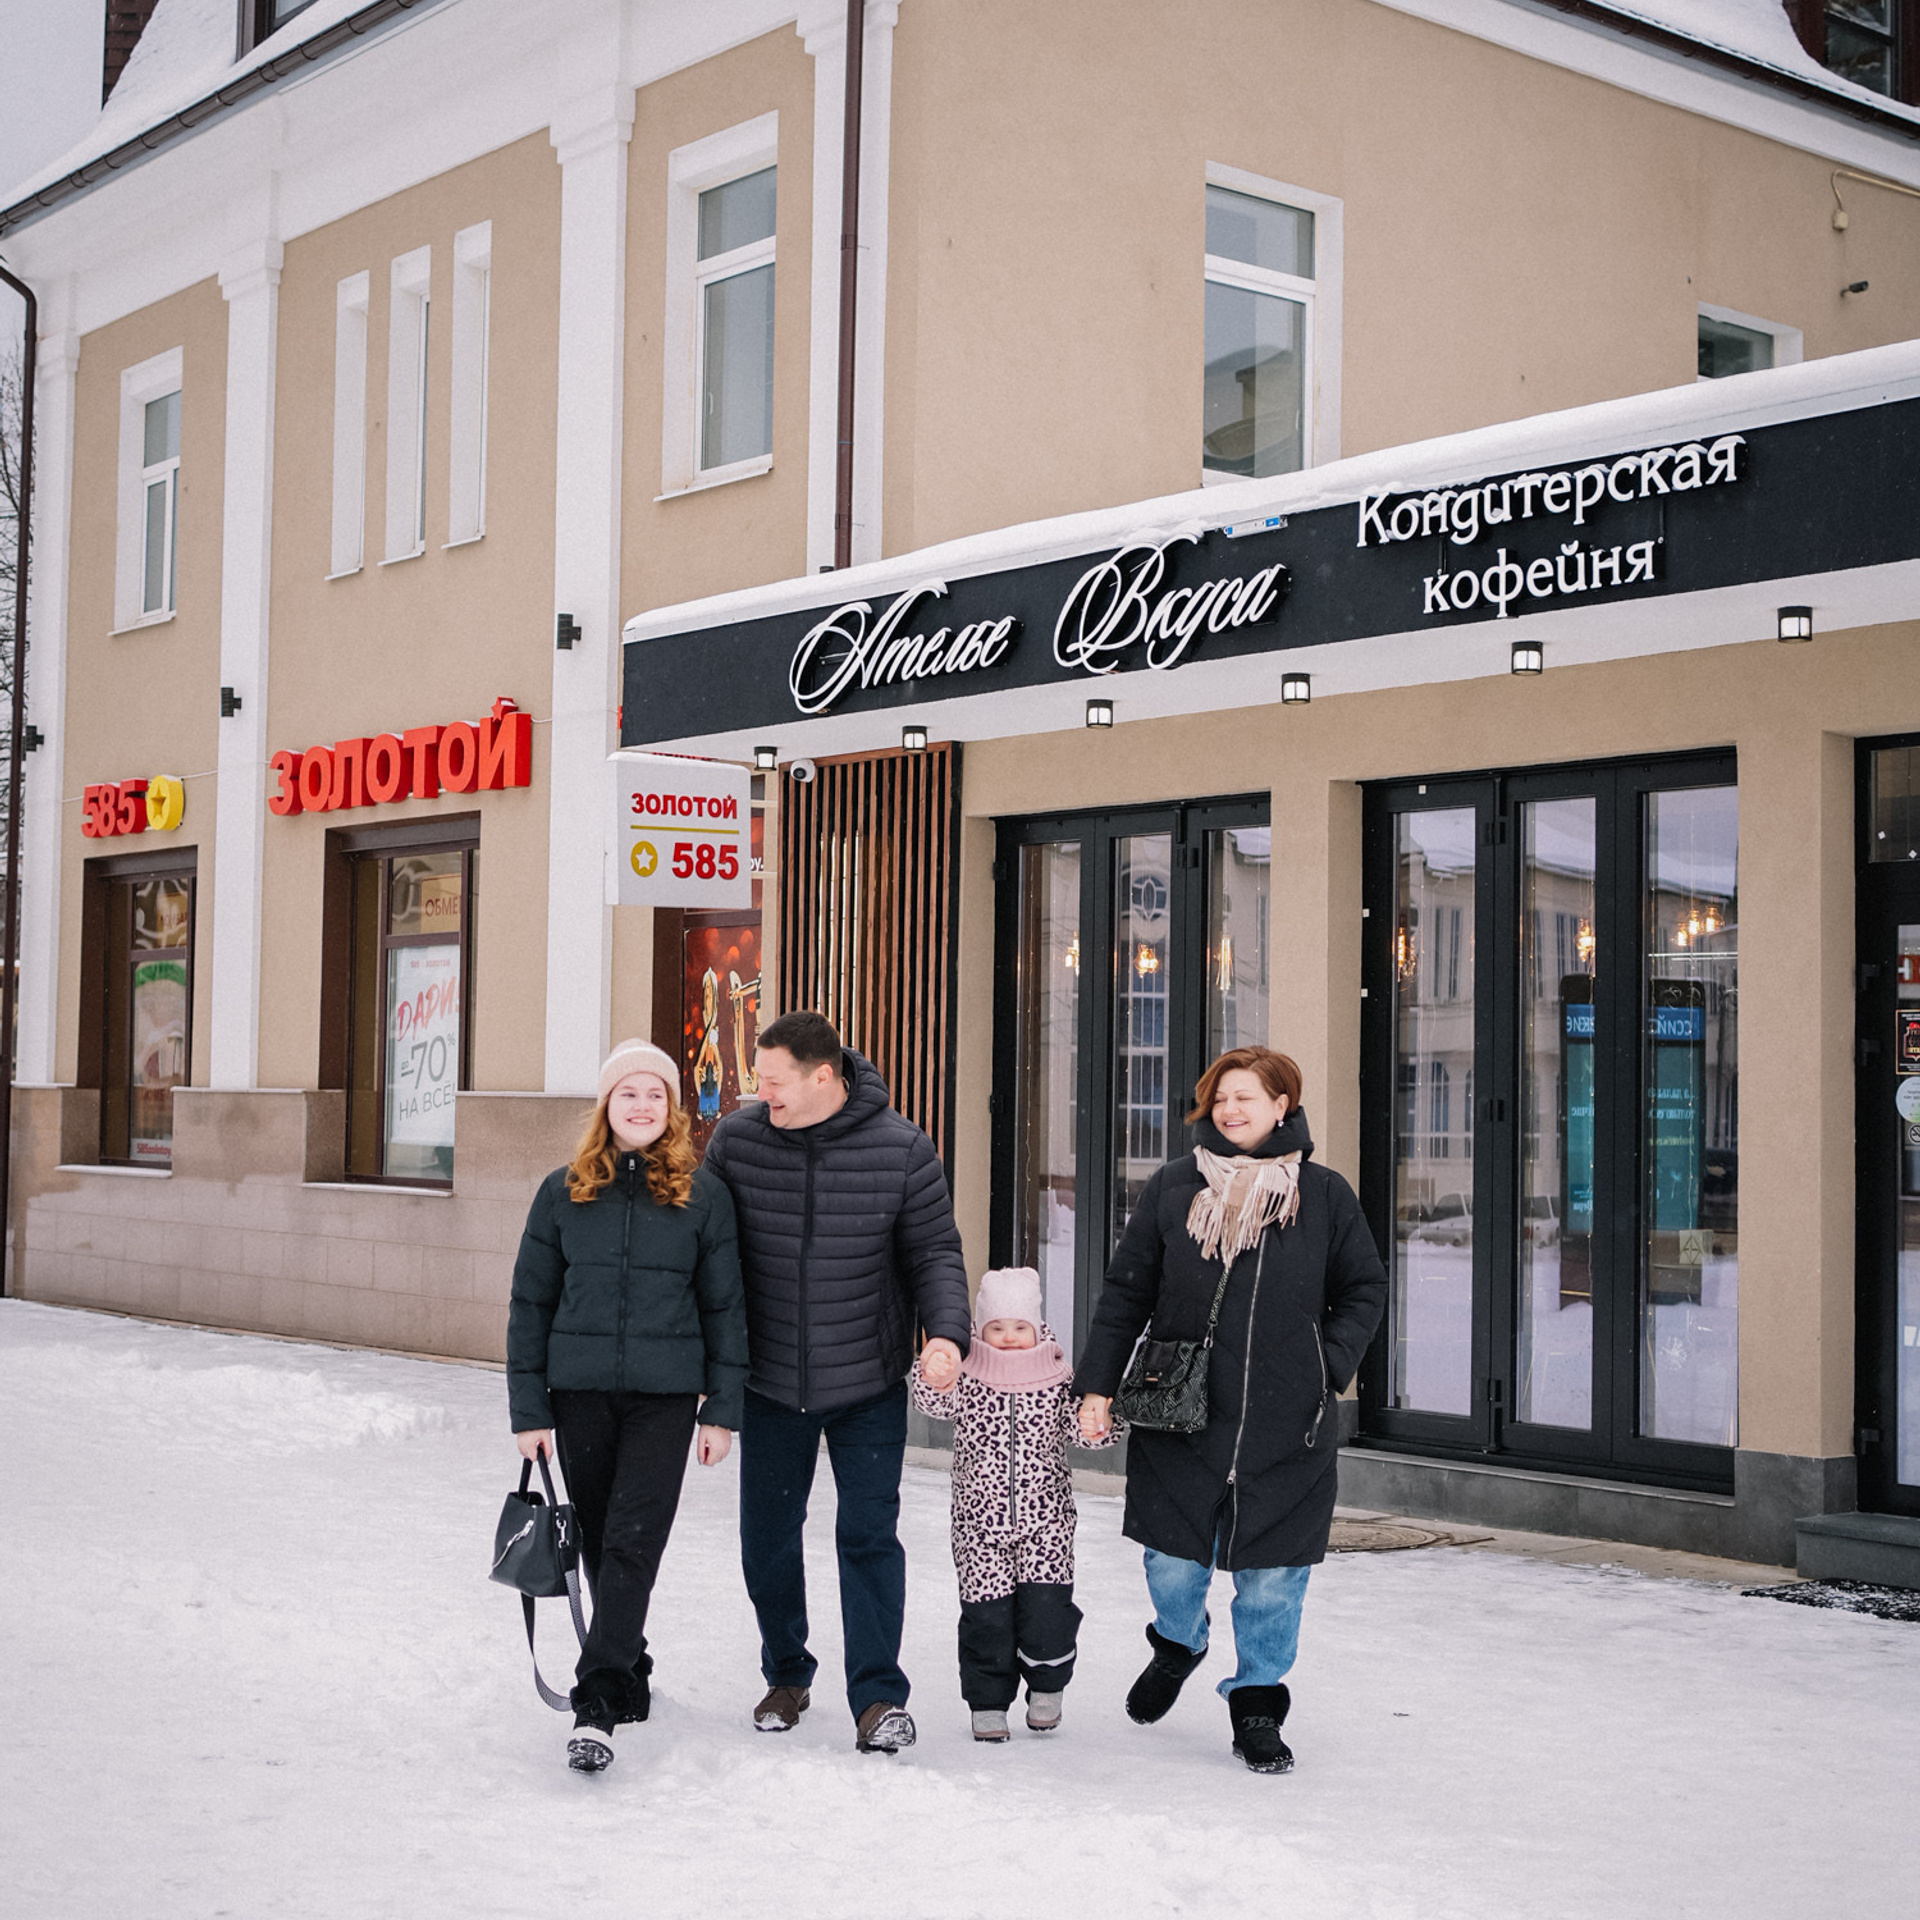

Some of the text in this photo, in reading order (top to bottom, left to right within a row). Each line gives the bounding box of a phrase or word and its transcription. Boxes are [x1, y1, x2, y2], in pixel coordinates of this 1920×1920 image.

[1356, 435, 1746, 547] Кондитерская
[1423, 540, 1656, 618] кофейня
[789, 534, 1287, 714] Ателье Вкуса
[268, 697, 531, 816] ЗОЛОТОЙ
[81, 779, 148, 838] 585
[631, 793, 737, 819] ЗОЛОТОЙ
[672, 842, 739, 880] 585
[399, 1098, 419, 1121] НА
